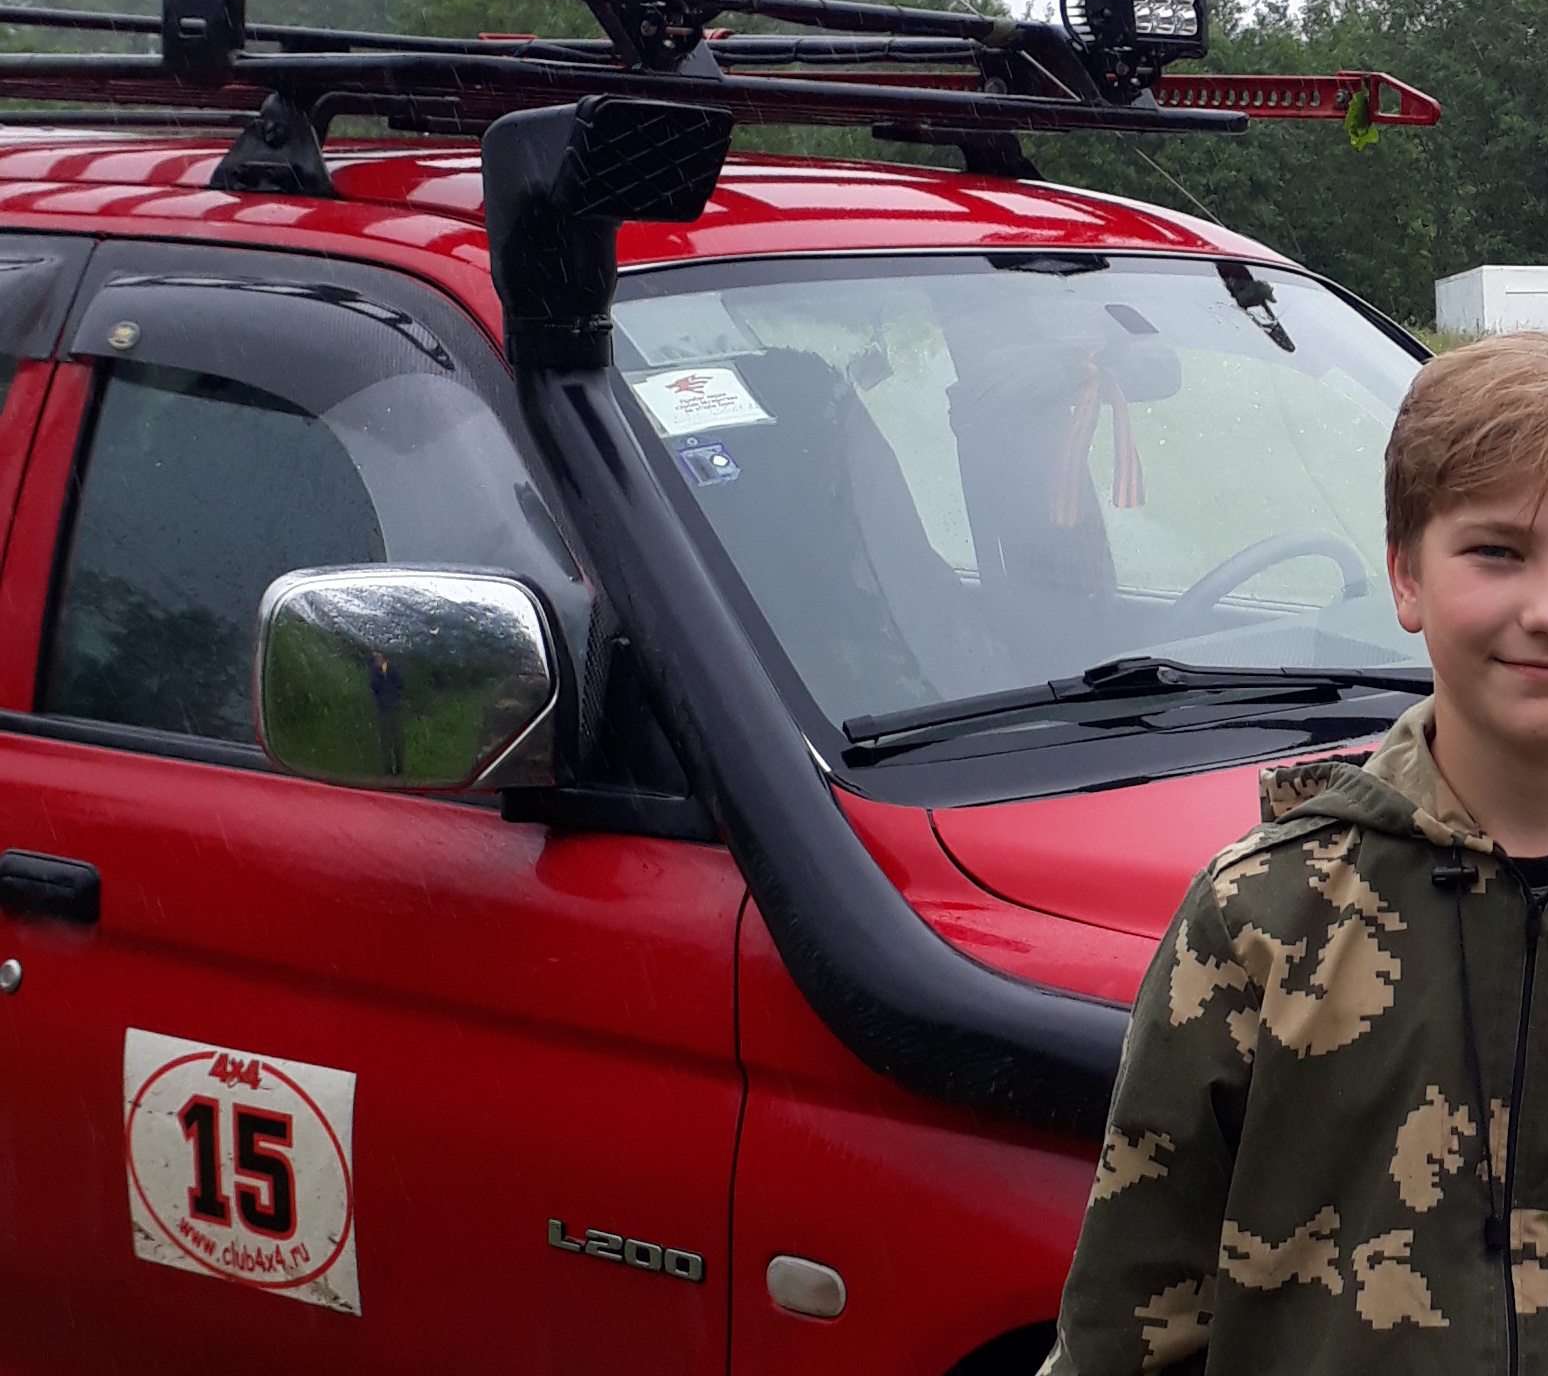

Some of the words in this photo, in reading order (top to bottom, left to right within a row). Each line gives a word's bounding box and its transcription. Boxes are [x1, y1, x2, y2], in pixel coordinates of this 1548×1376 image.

[177, 1093, 298, 1241] 15
[179, 1217, 311, 1274] www.club4x4.ru
[548, 1218, 705, 1282] L200
